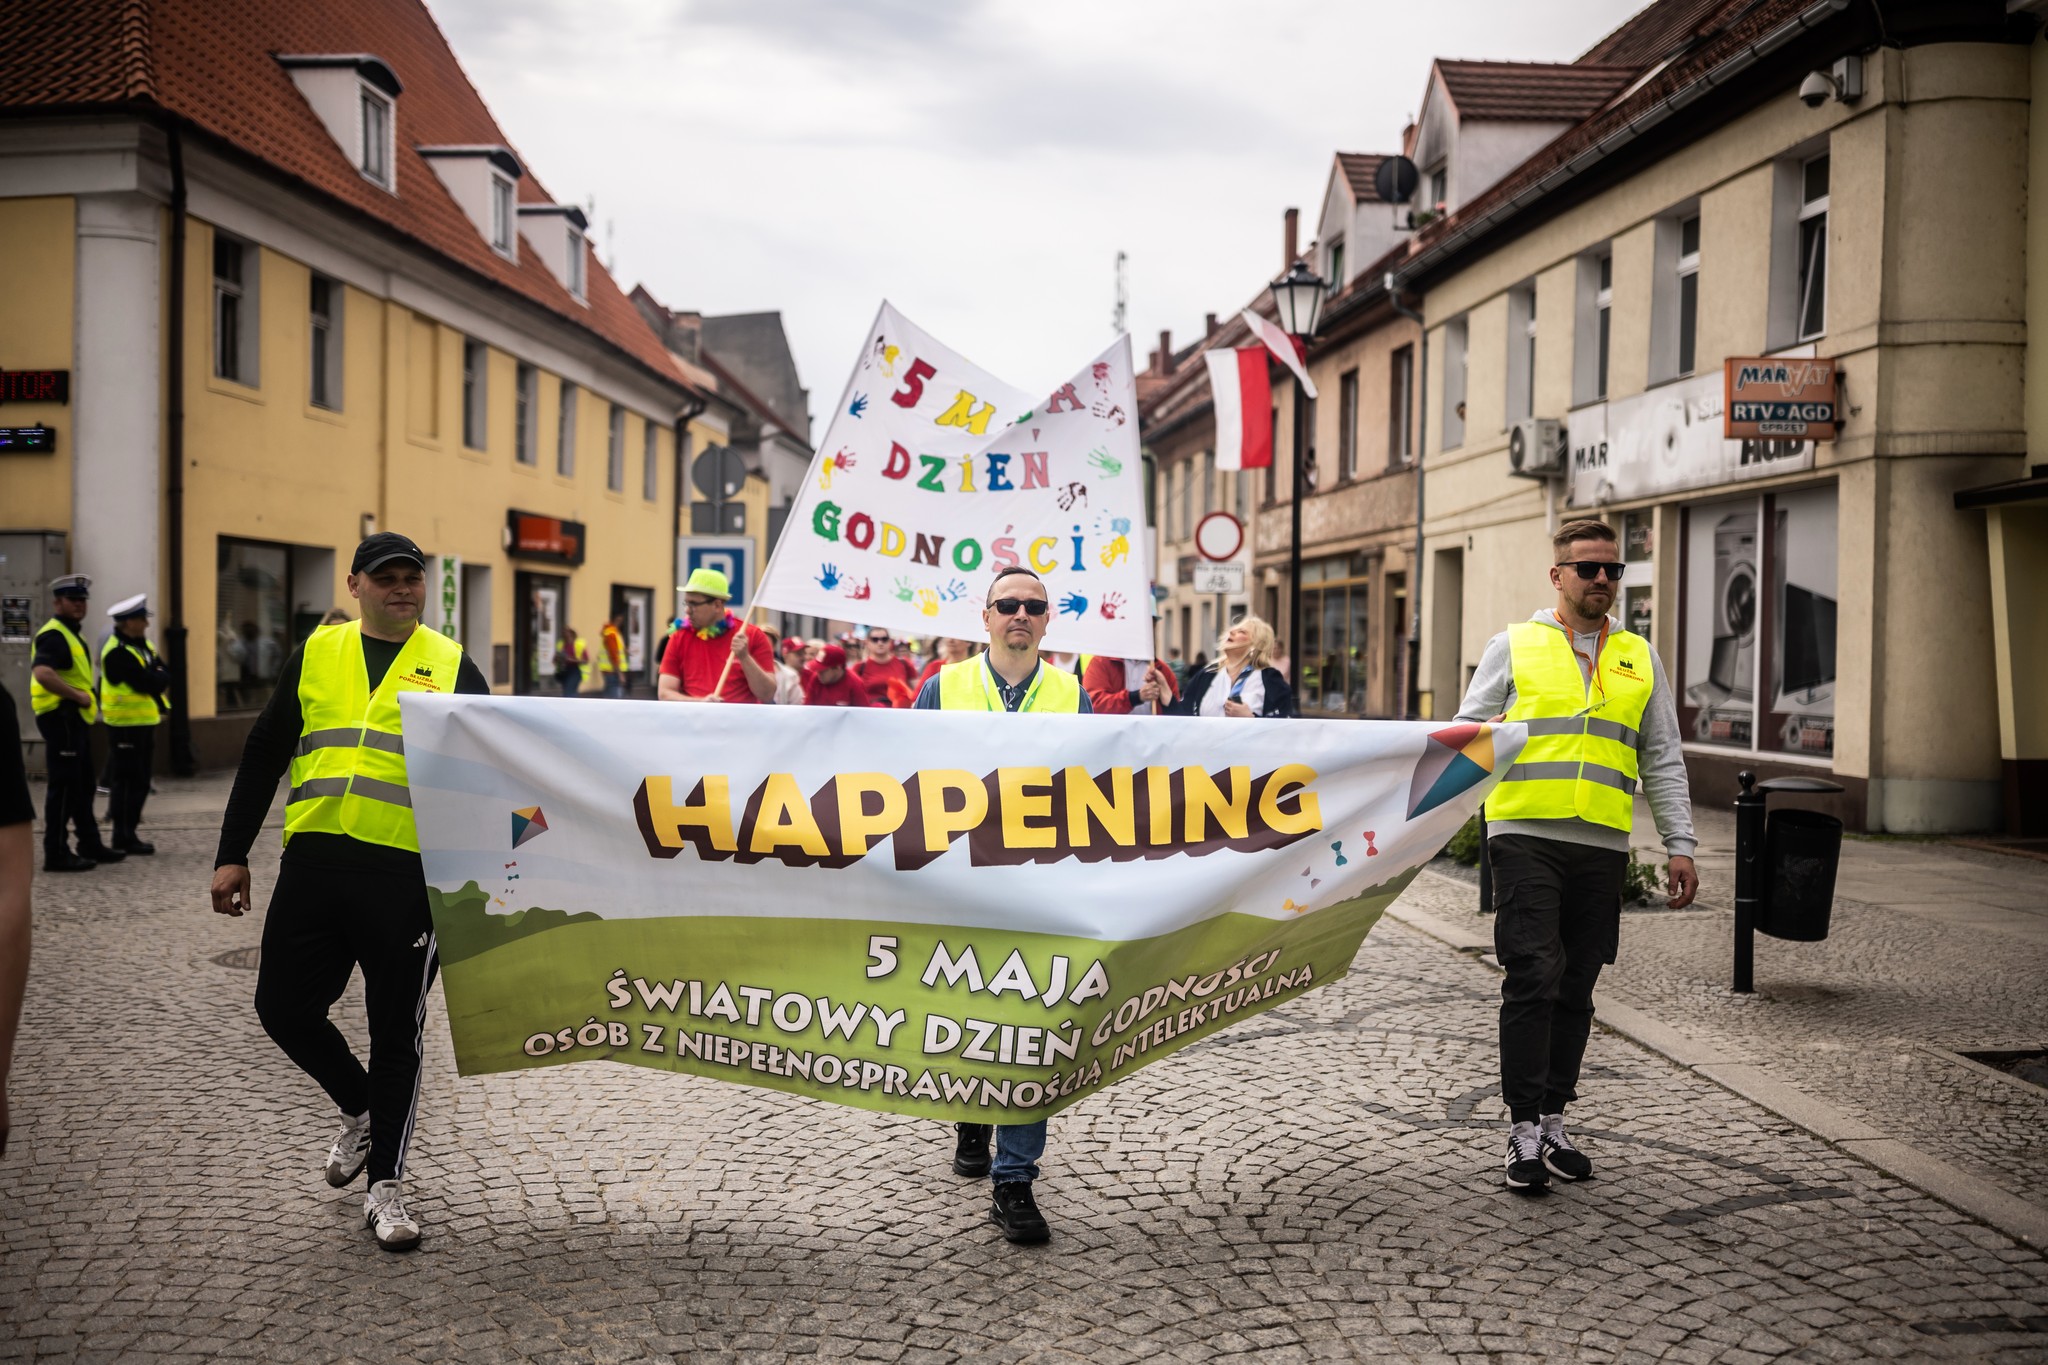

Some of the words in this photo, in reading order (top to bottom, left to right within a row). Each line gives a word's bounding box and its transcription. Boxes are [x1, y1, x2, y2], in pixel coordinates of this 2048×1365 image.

[890, 356, 938, 409] 5
[1734, 404, 1775, 420] RTV
[1787, 404, 1831, 421] AGD
[1735, 360, 1830, 397] MARWAT
[633, 763, 1323, 870] HAPPENING
[606, 968, 907, 1048] ŚWIATOWY
[922, 1012, 1083, 1067] DZIEŃ
[1091, 947, 1282, 1048] GODNOŚCI
[866, 935, 899, 980] 5
[919, 940, 1110, 1009] MAJA
[522, 1015, 630, 1057] OSÓB
[640, 1023, 666, 1055] Z
[677, 1028, 1103, 1110] NIEPEŁNOSPRAWNOŚCIĄ
[1110, 961, 1315, 1069] INTELEKTUALNĄ
